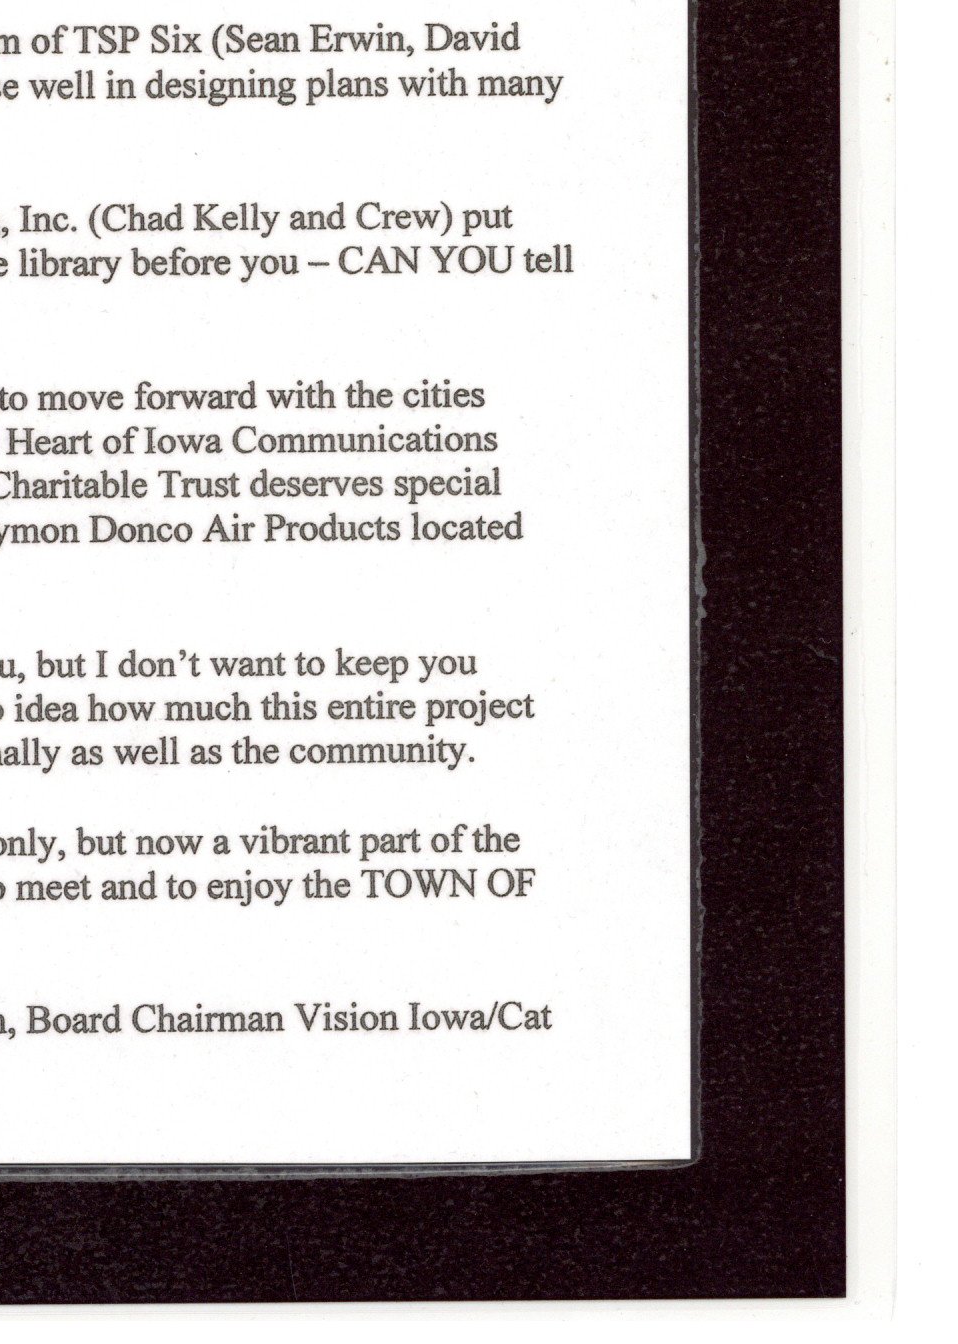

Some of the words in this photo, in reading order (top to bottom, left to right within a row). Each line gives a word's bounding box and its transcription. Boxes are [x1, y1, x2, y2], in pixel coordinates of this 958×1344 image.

[31, 25, 68, 54] of
[73, 25, 139, 54] TSP
[151, 24, 202, 53] Six
[212, 24, 300, 60] (Sean
[310, 23, 414, 57] Erwin,
[425, 22, 520, 51] David
[20, 205, 77, 232] Inc.
[89, 203, 184, 239] (Chad
[194, 203, 280, 238] Kelly
[290, 202, 346, 230] and
[356, 201, 452, 236] Crew)
[463, 205, 513, 236] put
[38, 391, 123, 410] move
[135, 381, 257, 410] forward
[267, 380, 336, 409] with
[345, 380, 393, 408] the
[403, 379, 485, 408] cities
[158, 471, 240, 498] Trust
[250, 469, 383, 497] deserves
[395, 467, 501, 504] special
[89, 515, 192, 543] Donco
[202, 513, 255, 542] Air
[265, 513, 400, 542] Products
[411, 511, 523, 540] located
[72, 746, 103, 765] as
[114, 736, 179, 765] well
[191, 745, 222, 764] as
[232, 736, 279, 764] the
[290, 734, 474, 770] community.
[27, 1004, 122, 1034] Board
[132, 1004, 285, 1033] Chairman
[294, 1002, 399, 1031] Vision
[409, 1001, 552, 1030] Iowa/Cat
